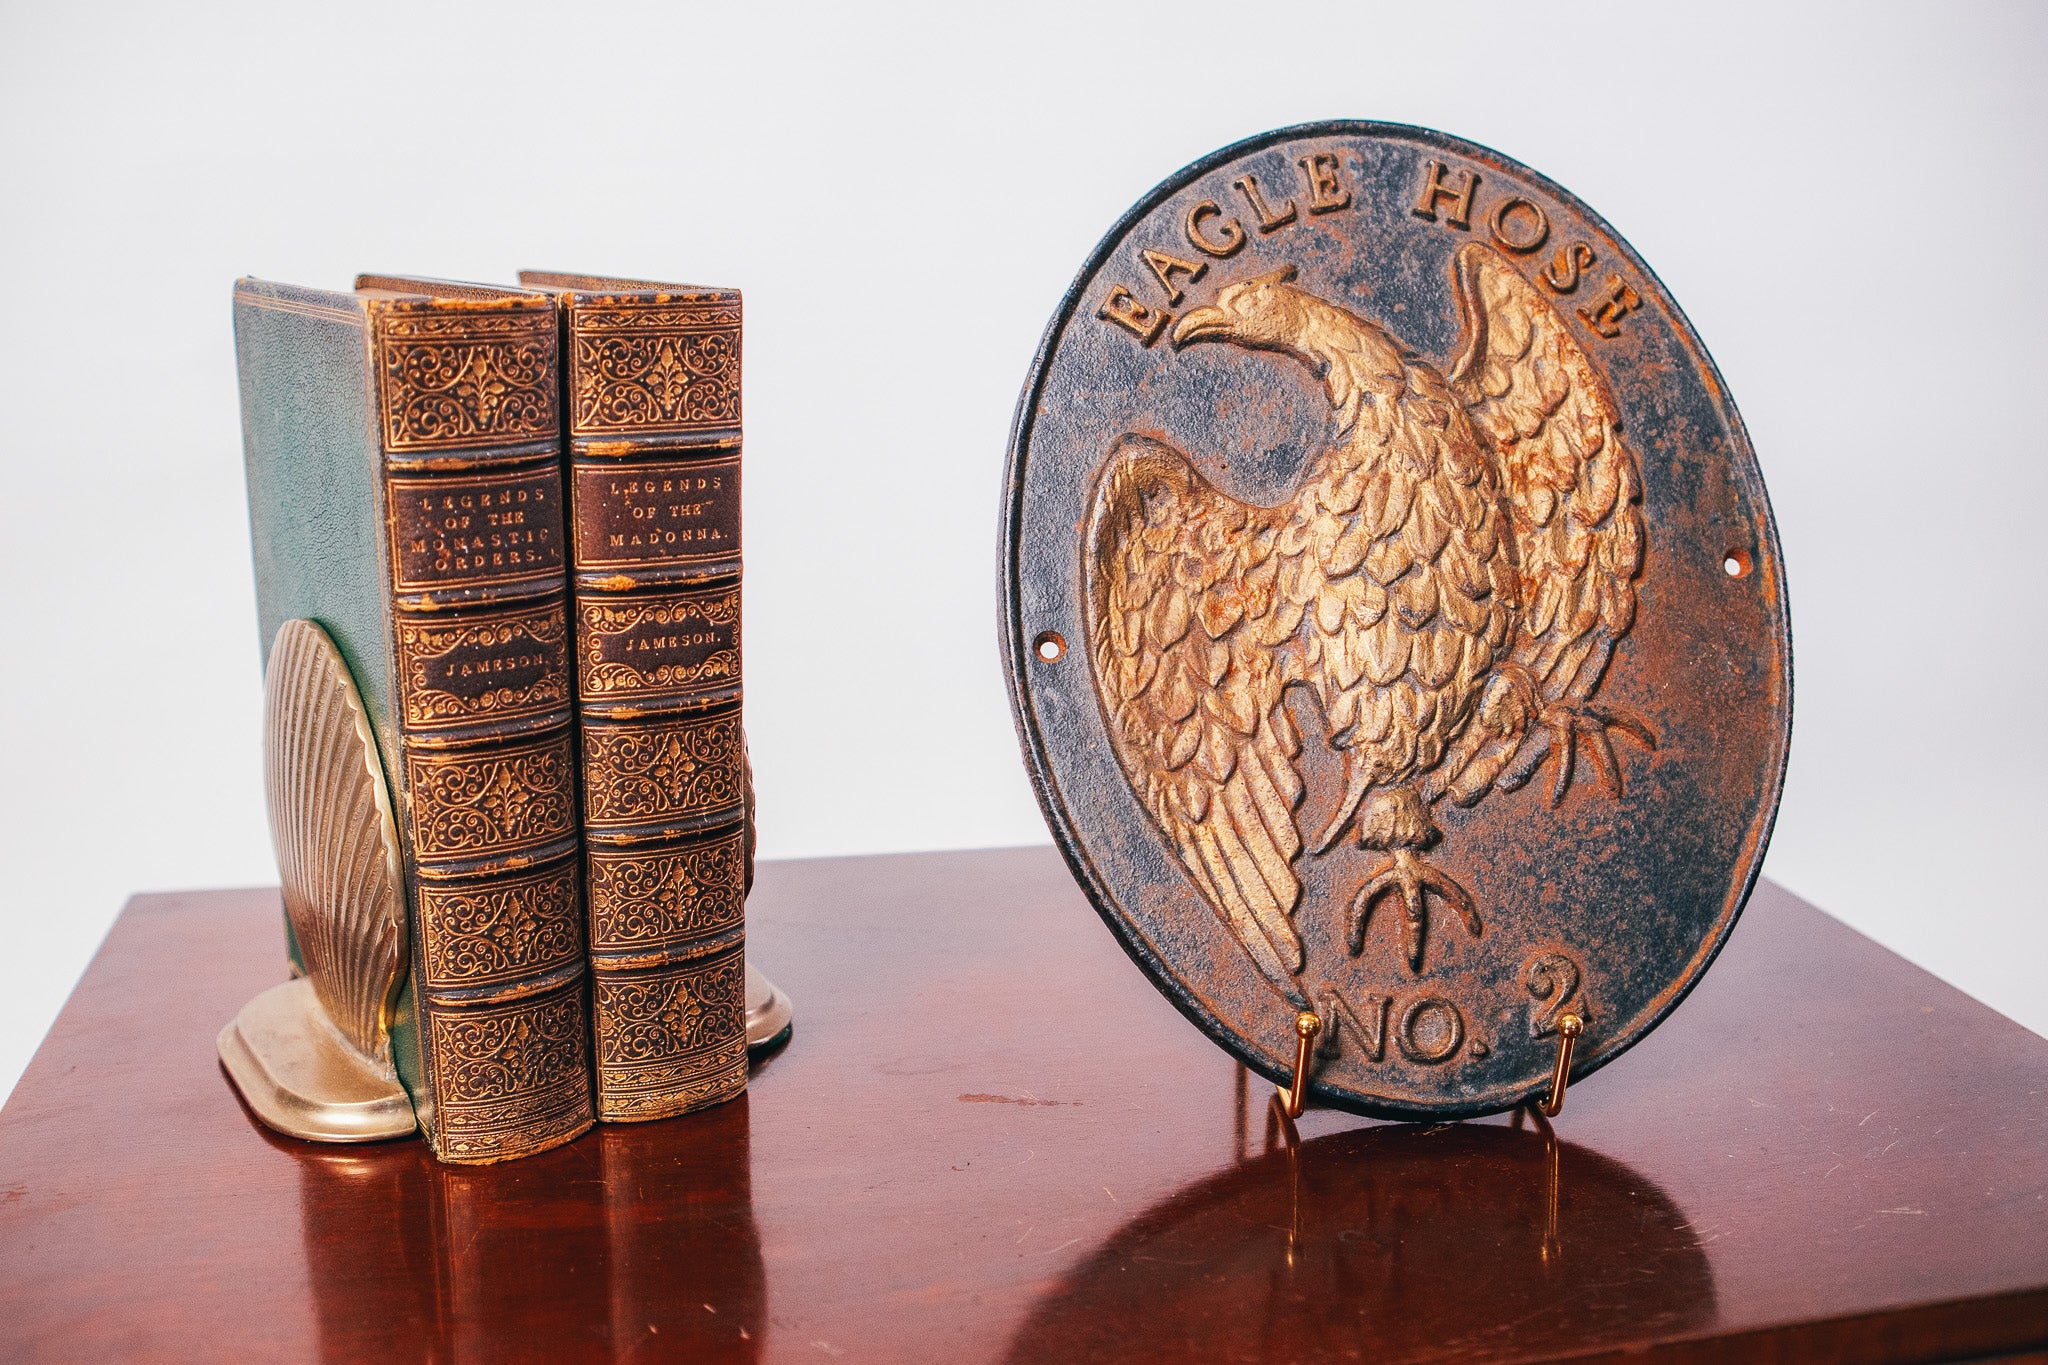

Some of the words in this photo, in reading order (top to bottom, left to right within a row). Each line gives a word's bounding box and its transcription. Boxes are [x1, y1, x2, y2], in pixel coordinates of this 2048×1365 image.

[1095, 152, 1351, 349] EAGLE
[1411, 159, 1645, 339] HOSE
[610, 476, 722, 495] LEGENDS
[421, 488, 545, 511] LEGENDS
[444, 516, 470, 530] OF
[487, 511, 524, 526] THE
[632, 506, 656, 519] OF
[669, 503, 702, 517] THE
[410, 528, 549, 553] MONASTIC
[609, 527, 729, 546] MADONNA.
[435, 549, 543, 571] ORDERS.
[625, 631, 722, 652] JAMESON.
[446, 653, 549, 677] JAMESON.
[1316, 988, 1490, 1064] NO.
[1525, 953, 1594, 1040] 2
